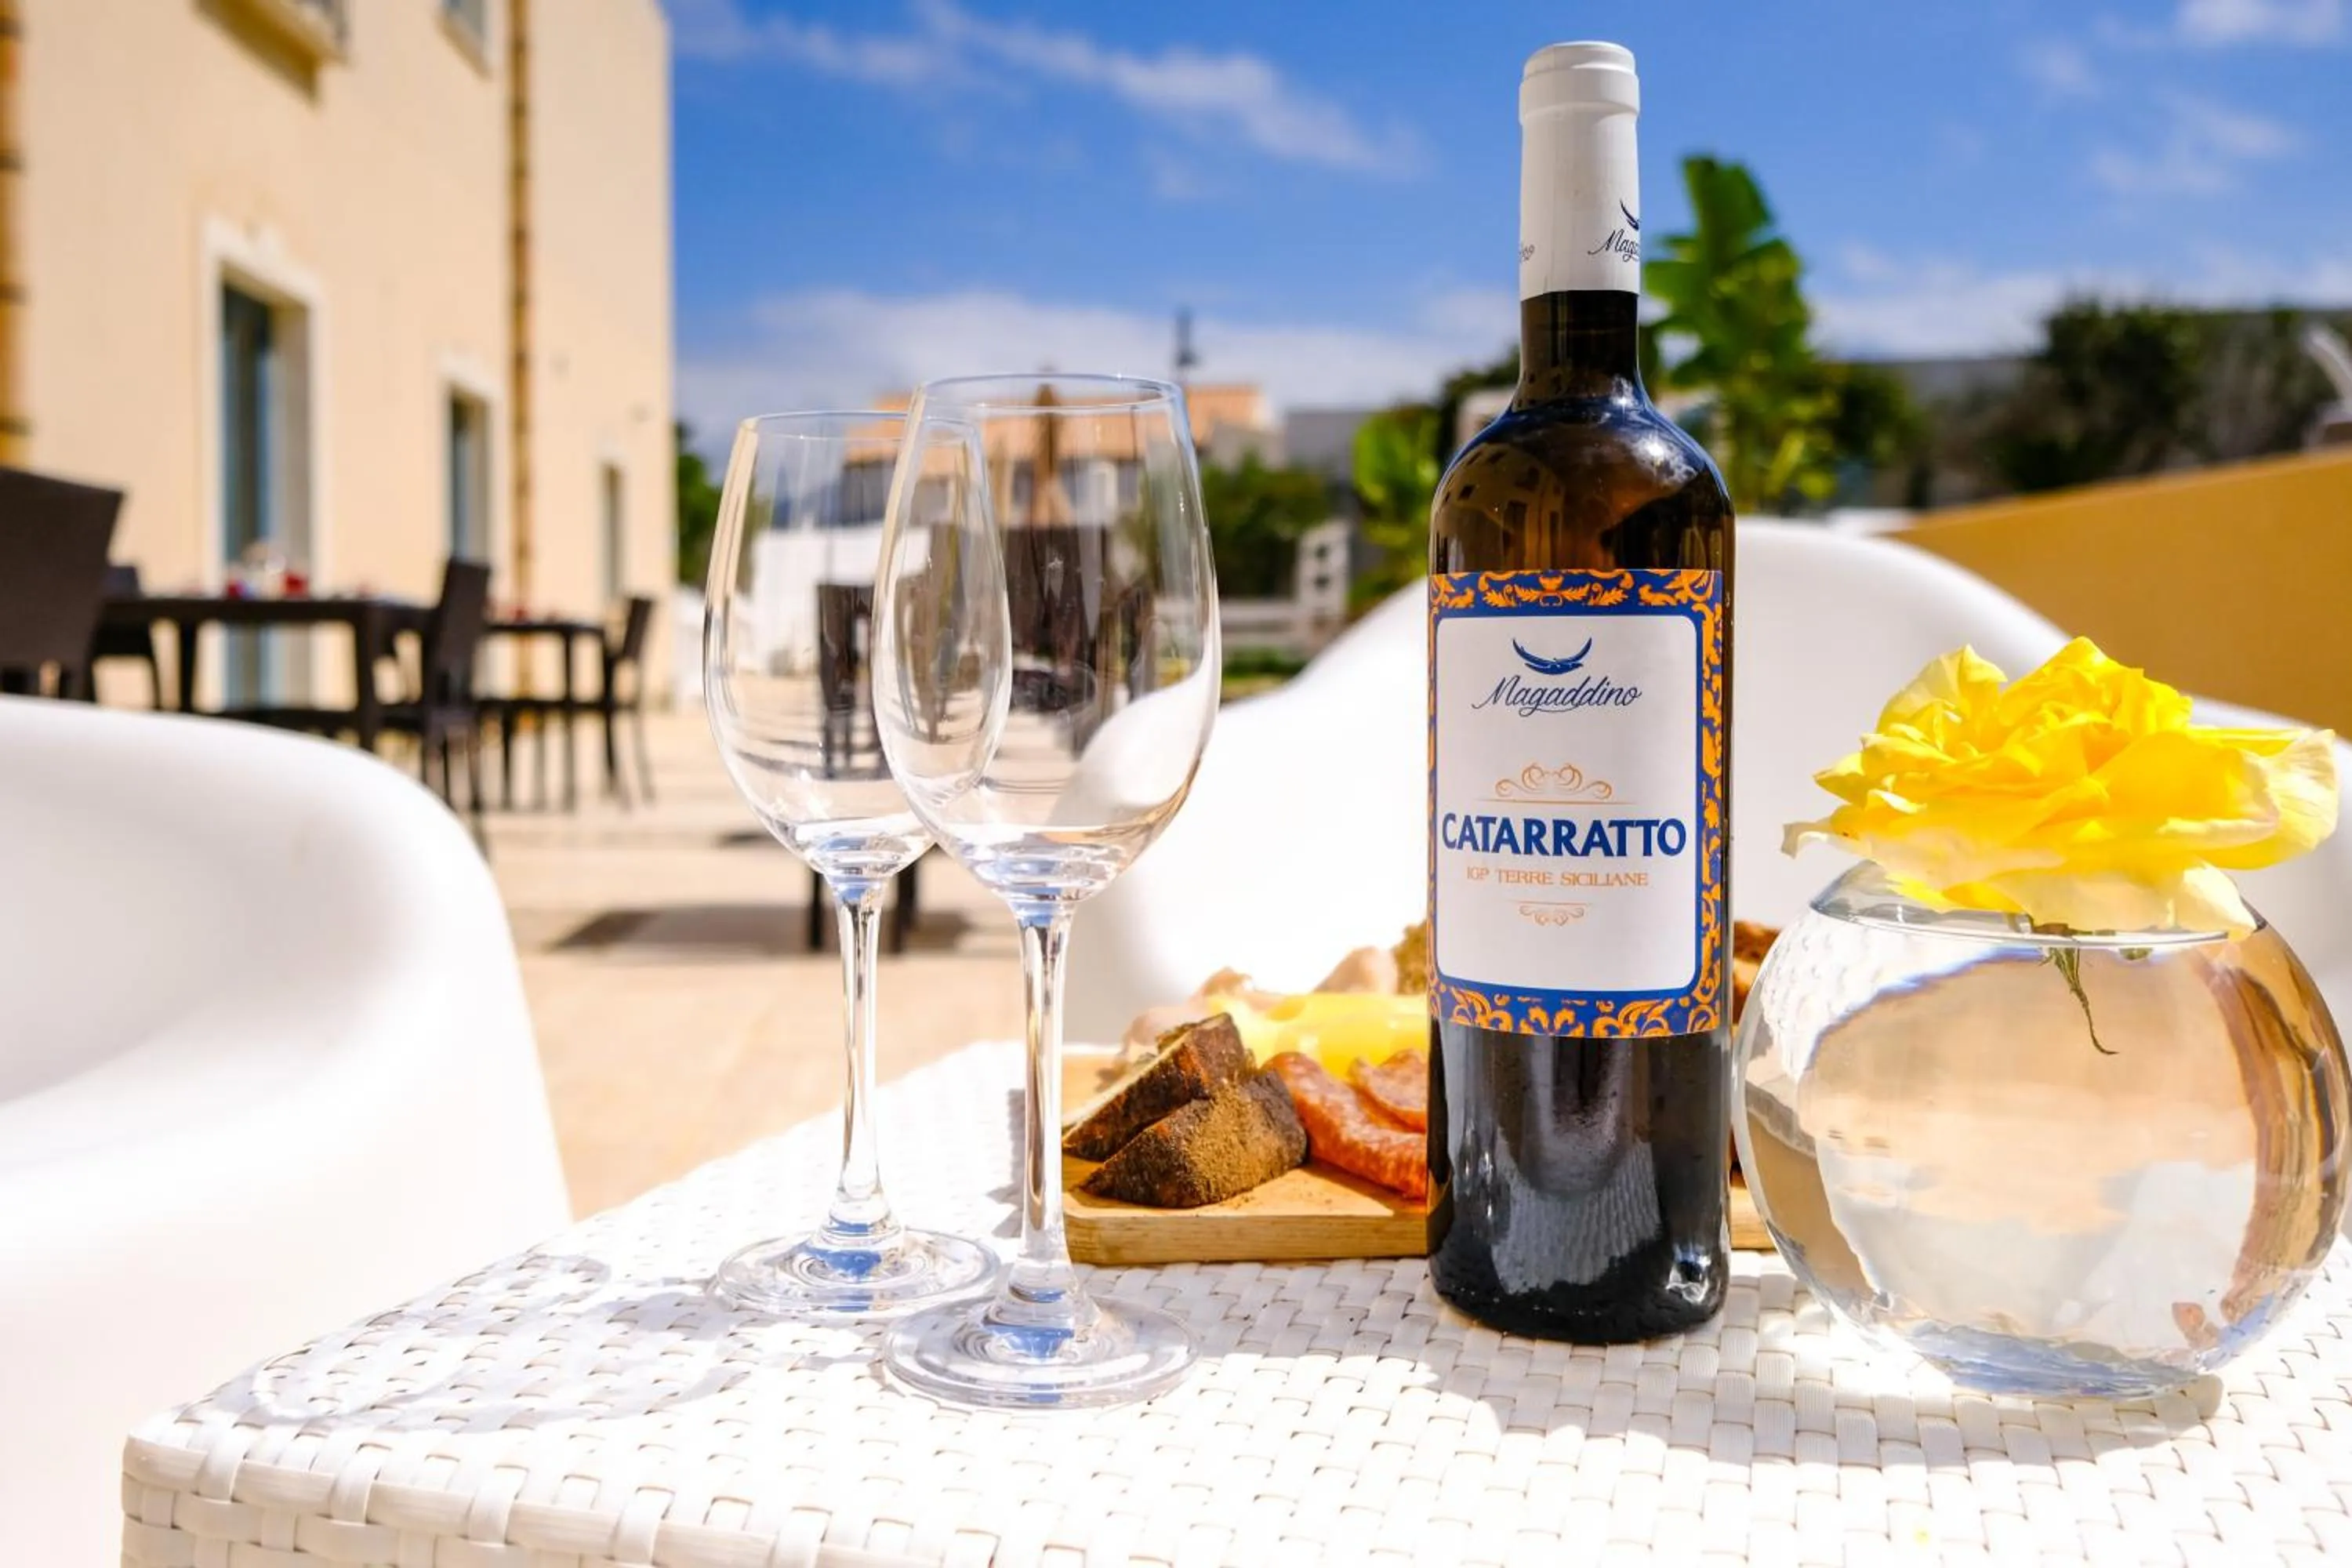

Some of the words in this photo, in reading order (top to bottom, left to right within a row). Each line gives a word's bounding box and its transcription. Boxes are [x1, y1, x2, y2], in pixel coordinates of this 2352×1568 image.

[1471, 674, 1642, 717] Magaddino
[1442, 812, 1686, 857] CATARRATTO
[1467, 866, 1490, 880] IGP
[1495, 869, 1554, 886] TERRE
[1560, 872, 1649, 887] SICILIANE
